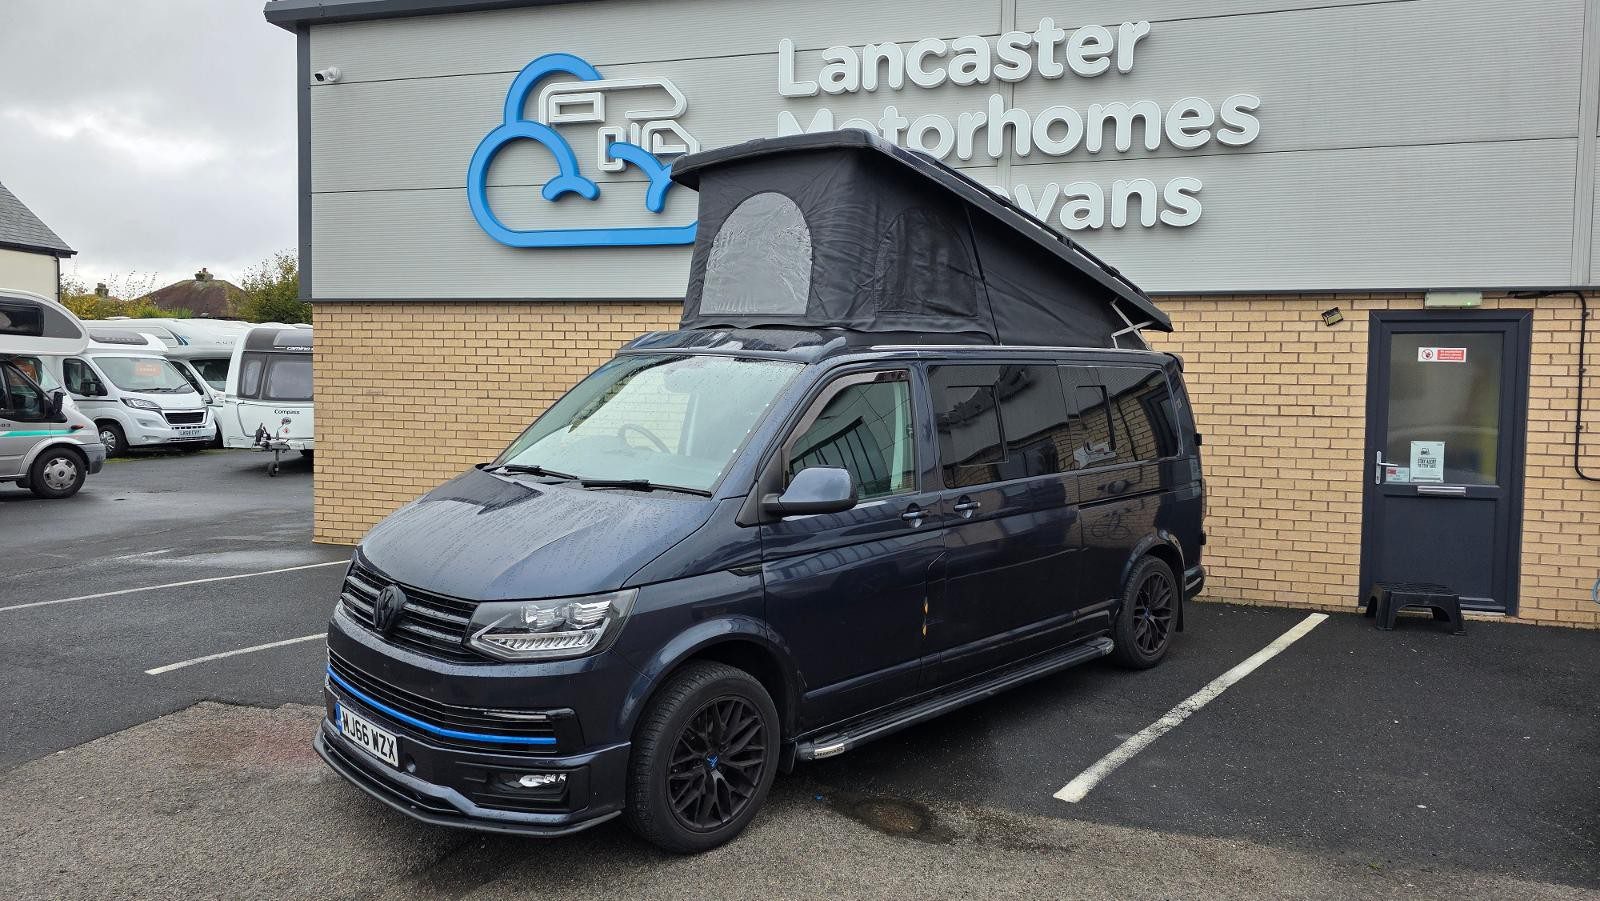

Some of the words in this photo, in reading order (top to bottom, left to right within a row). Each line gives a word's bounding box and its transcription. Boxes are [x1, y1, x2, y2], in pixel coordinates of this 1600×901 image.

[777, 16, 1152, 99] Lancaster
[987, 176, 1203, 230] vans
[370, 728, 396, 762] WZX
